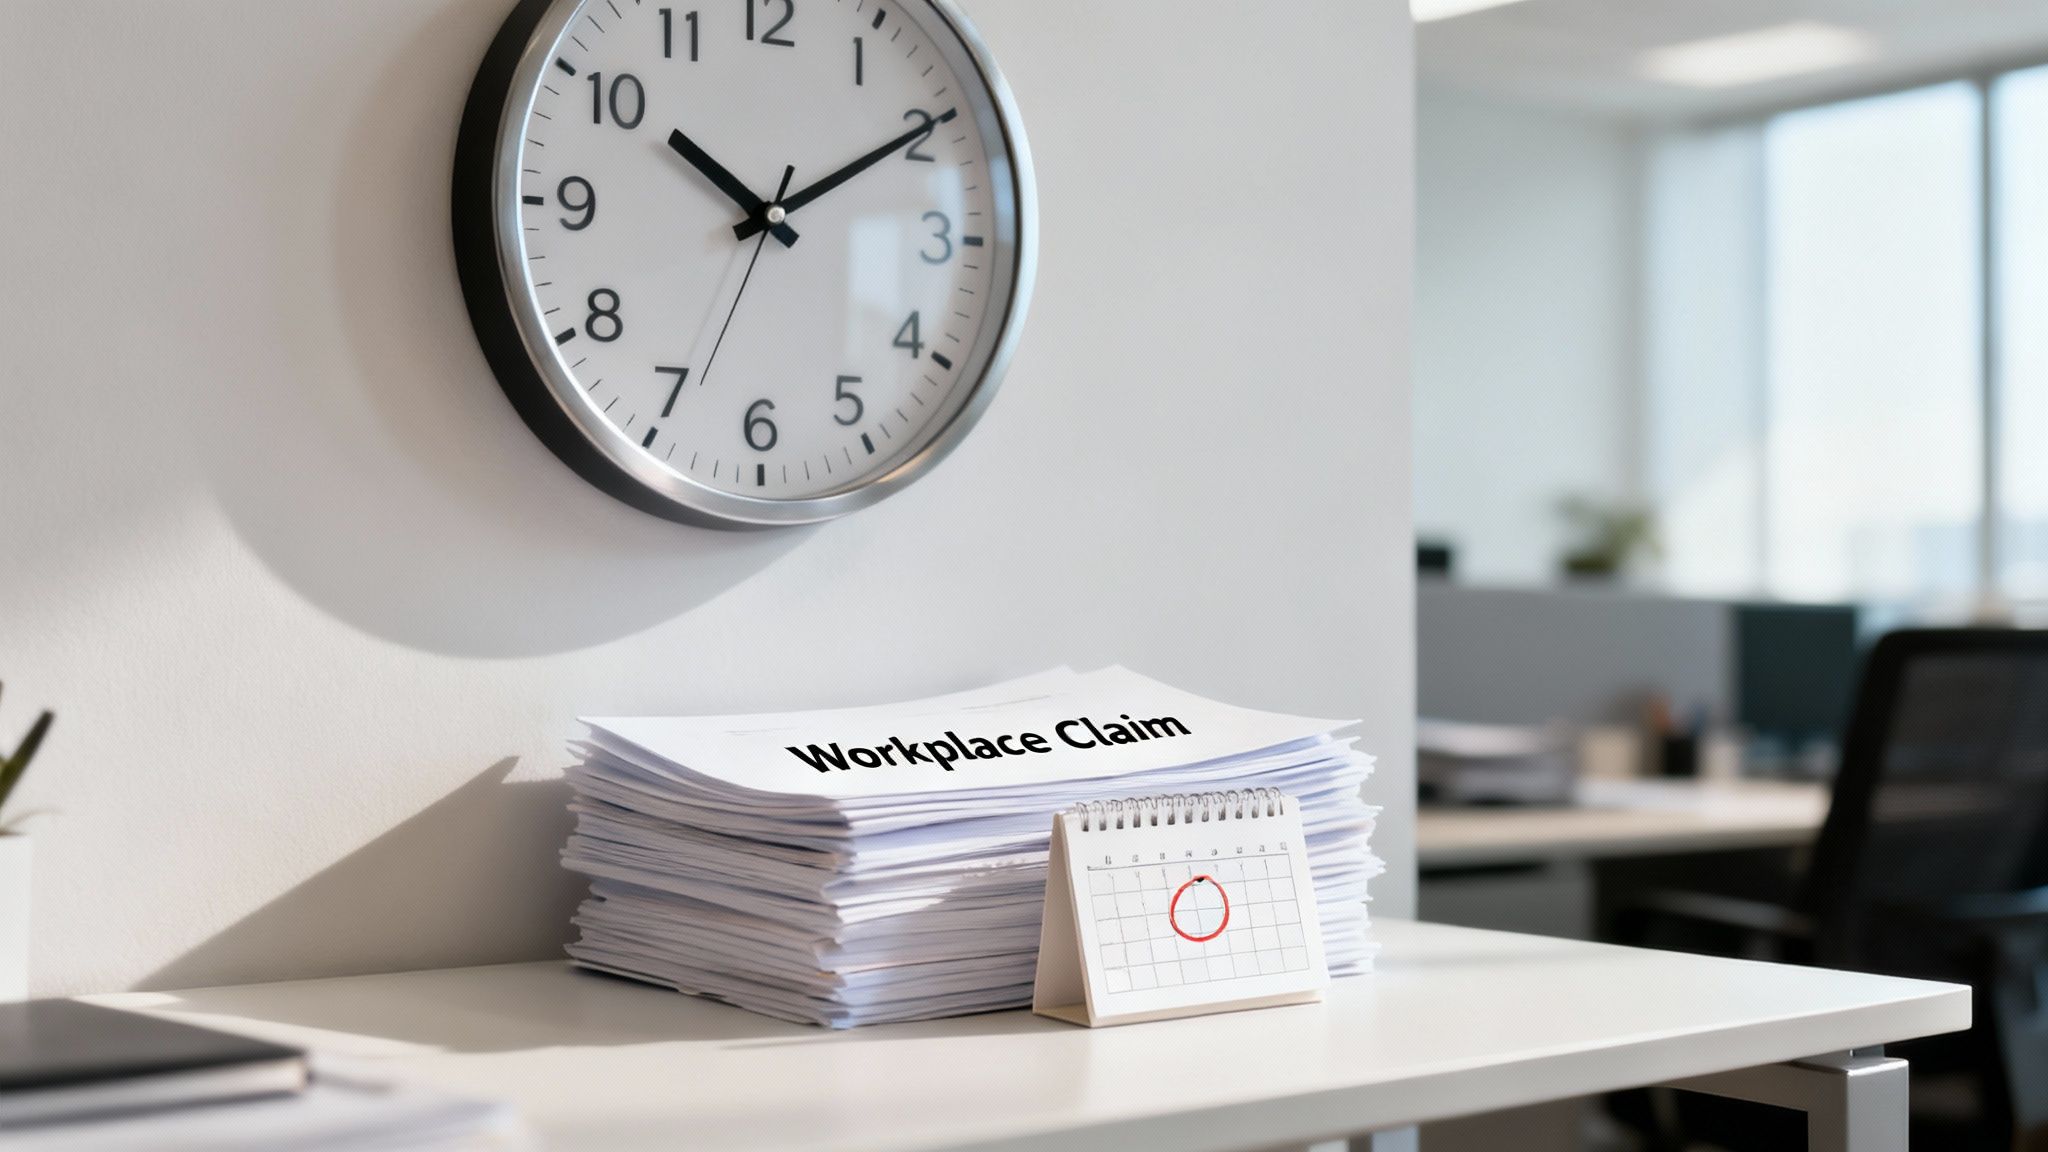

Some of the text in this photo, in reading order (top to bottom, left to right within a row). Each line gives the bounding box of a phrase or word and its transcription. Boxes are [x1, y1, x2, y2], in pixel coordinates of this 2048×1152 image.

[658, 8, 699, 62] 11
[746, 0, 795, 47] 12
[852, 37, 864, 87] 1
[587, 72, 646, 130] 10
[903, 109, 935, 162] 2
[557, 176, 597, 231] 9
[920, 211, 953, 265] 3
[585, 288, 624, 343] 8
[892, 311, 925, 359] 4
[655, 366, 690, 418] 7
[833, 375, 865, 426] 5
[743, 399, 778, 452] 6
[785, 714, 1192, 774] Workplace Claim
